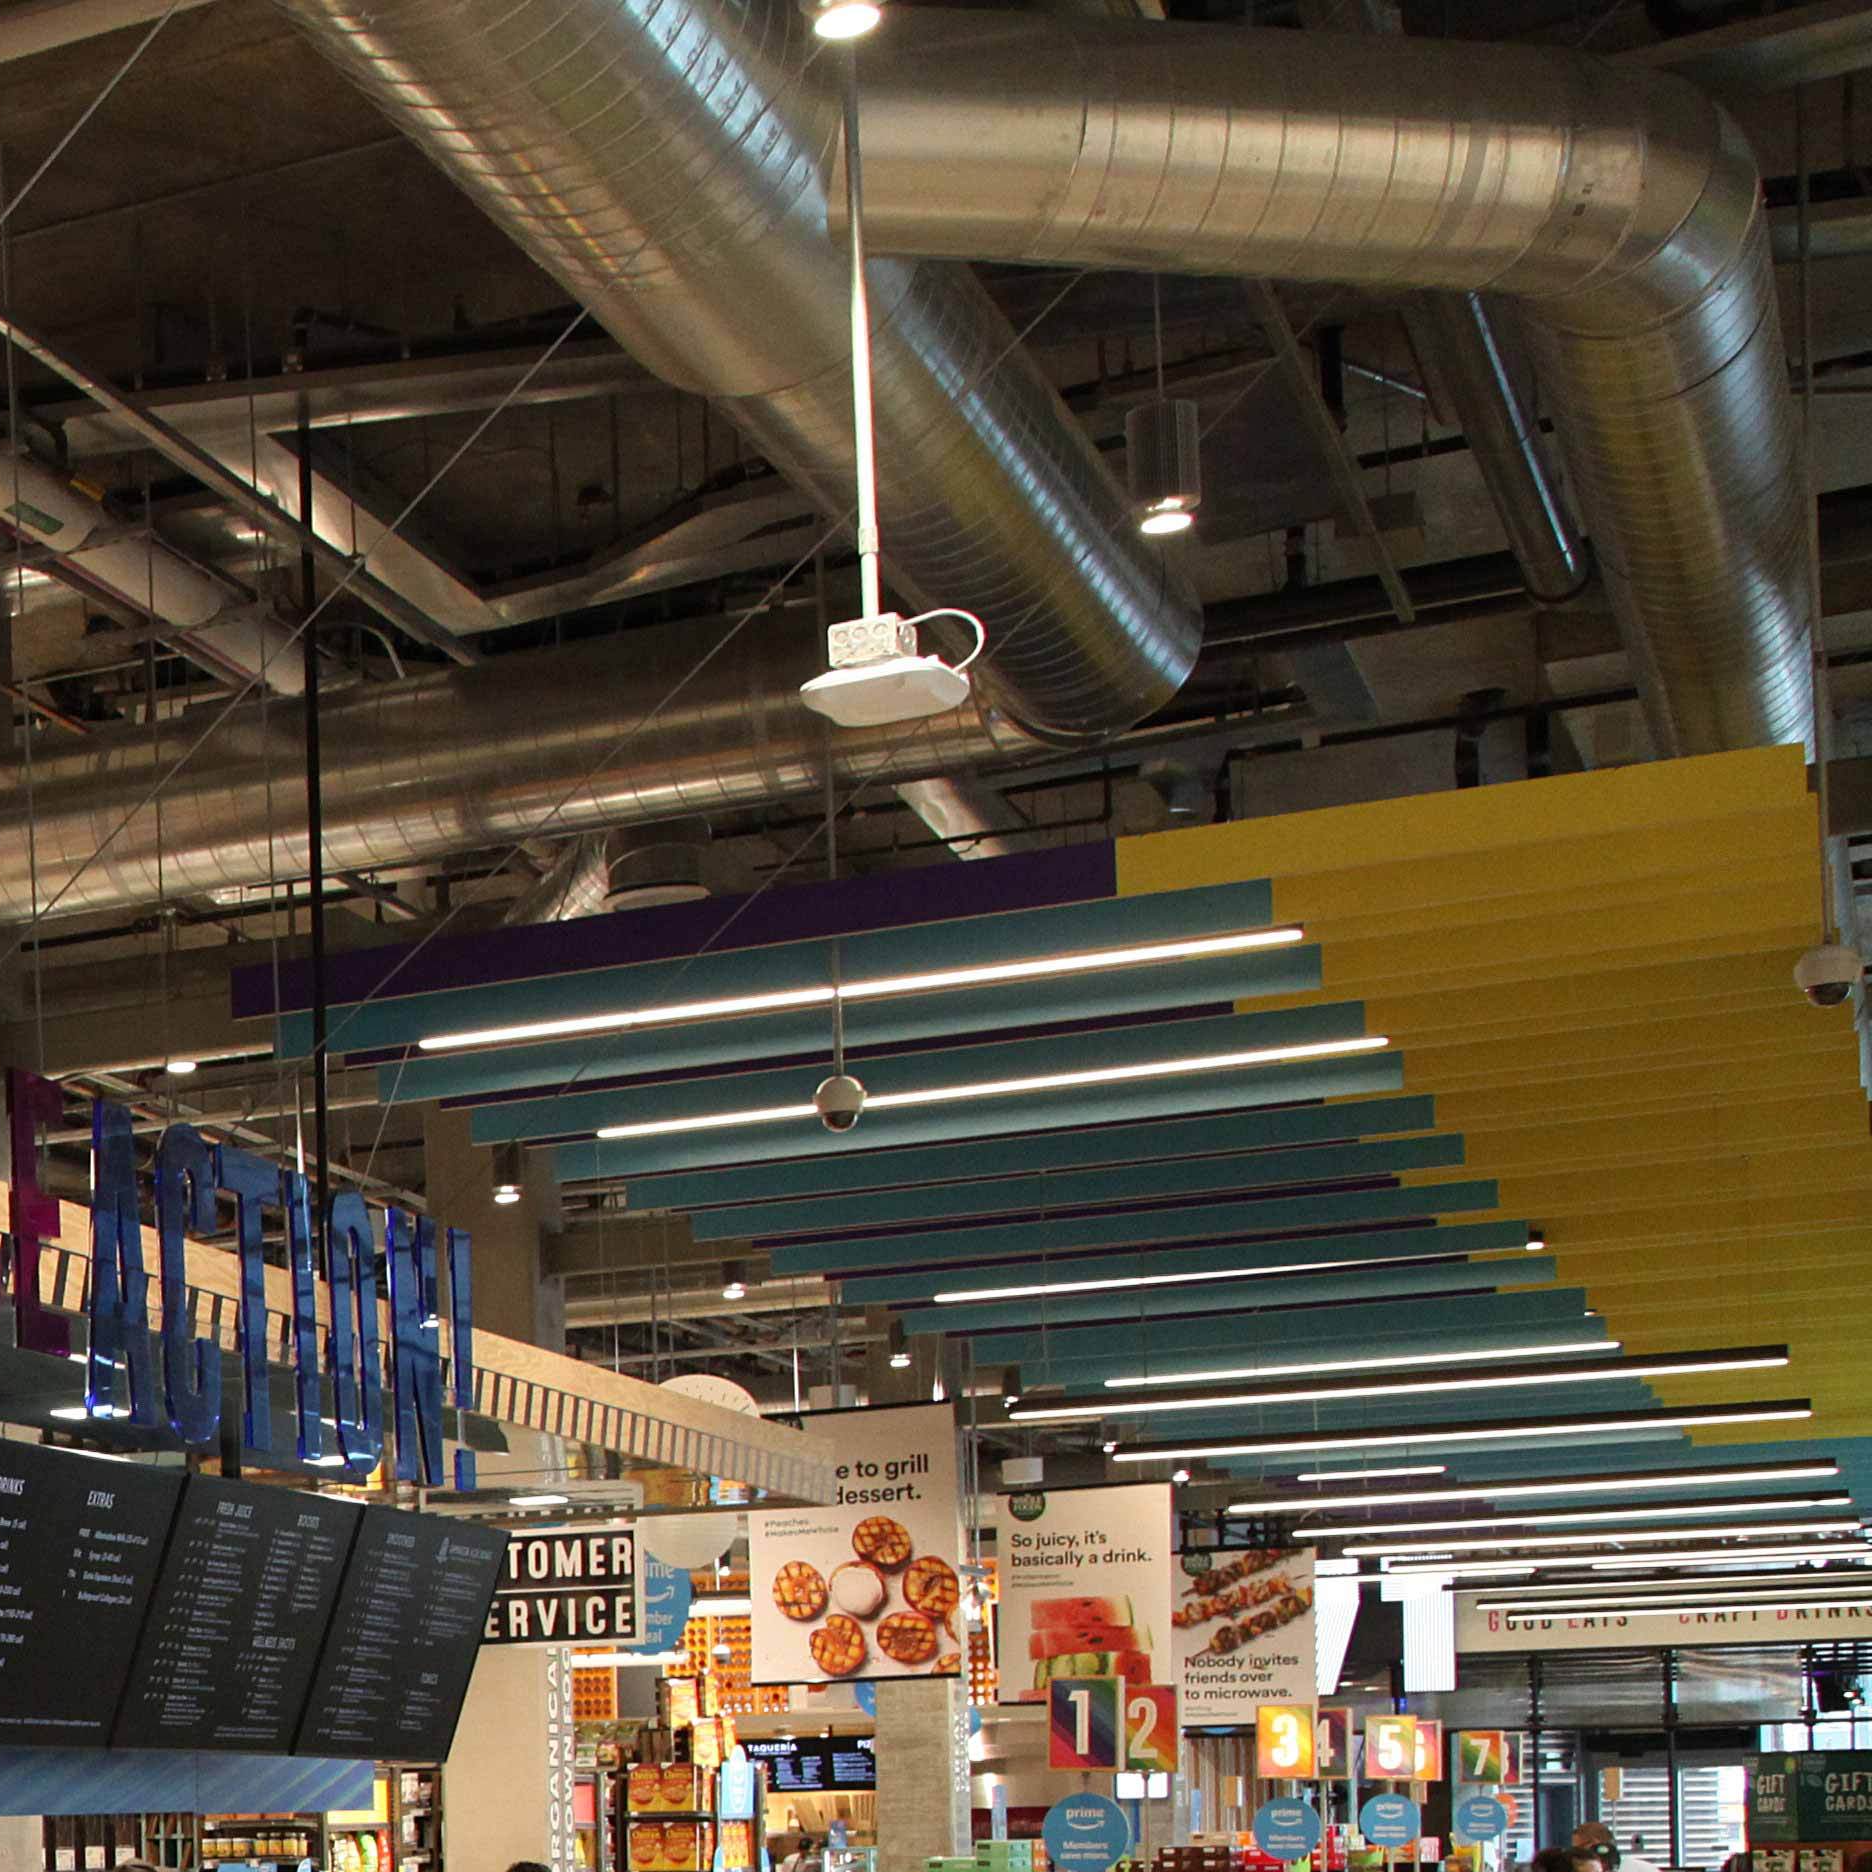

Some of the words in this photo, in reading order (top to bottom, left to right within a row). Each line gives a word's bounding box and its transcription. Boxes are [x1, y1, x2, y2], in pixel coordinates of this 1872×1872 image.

[85, 1095, 474, 1491] ACTION!
[856, 1460, 879, 1479] to
[886, 1454, 929, 1482] grill
[835, 1483, 922, 1506] dessert.
[1011, 1533, 1032, 1548] So
[1035, 1533, 1080, 1550] juicy,
[1083, 1531, 1107, 1546] it's
[508, 1537, 634, 1580] TOMER
[1011, 1552, 1084, 1569] basically
[1088, 1554, 1098, 1565] a
[1103, 1550, 1152, 1565] drink.
[484, 1596, 633, 1639] ERVICE
[1184, 1656, 1244, 1670] Nobody
[1249, 1654, 1299, 1668] invites
[1184, 1671, 1236, 1685] friends
[1240, 1673, 1273, 1683] over
[1185, 1688, 1200, 1700] to
[1204, 1687, 1293, 1699] microwave.
[1067, 1690, 1091, 1756] 1
[1127, 1696, 1158, 1759] 2
[857, 1740, 872, 1750] PIZ
[1270, 1714, 1300, 1769] 3
[1317, 1719, 1336, 1769] 4
[1378, 1725, 1403, 1770] 5
[1469, 1739, 1492, 1777] 7
[1758, 1774, 1786, 1795] GIFT
[1825, 1772, 1872, 1793] GIFT
[1825, 1794, 1872, 1812] CARDS
[1066, 1807, 1105, 1821] prime
[1271, 1808, 1302, 1820] prime
[1063, 1840, 1109, 1851] Members
